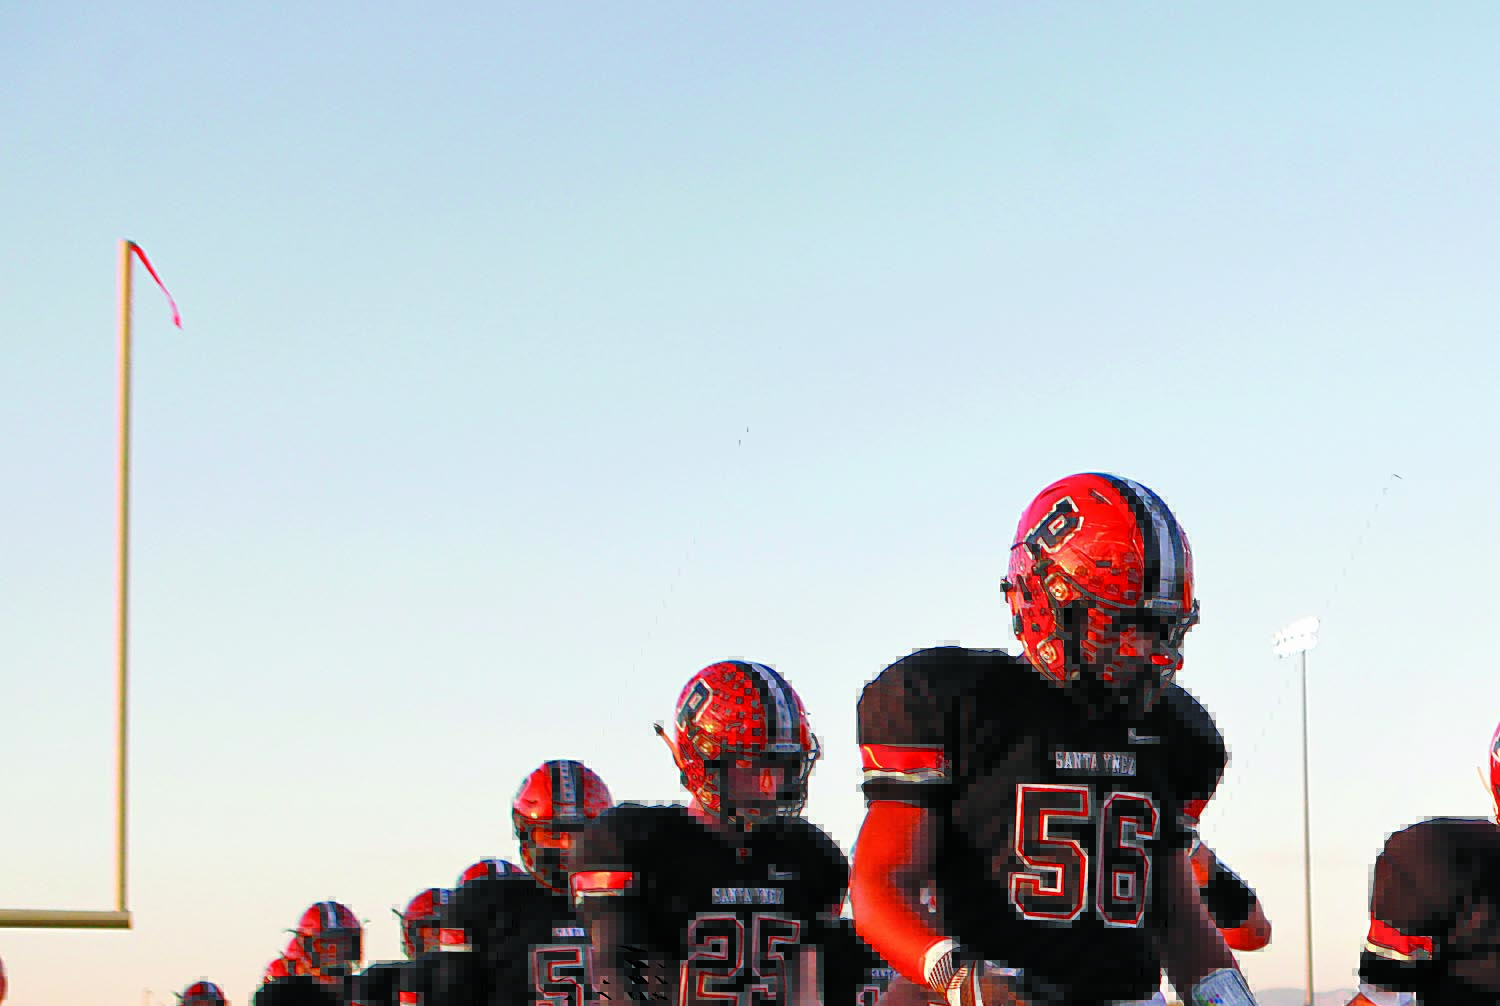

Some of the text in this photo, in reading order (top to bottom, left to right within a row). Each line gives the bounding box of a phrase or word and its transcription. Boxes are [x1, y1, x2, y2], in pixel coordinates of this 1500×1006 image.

[1055, 750, 1136, 776] SANTA YNEZ
[1009, 783, 1160, 928] 56
